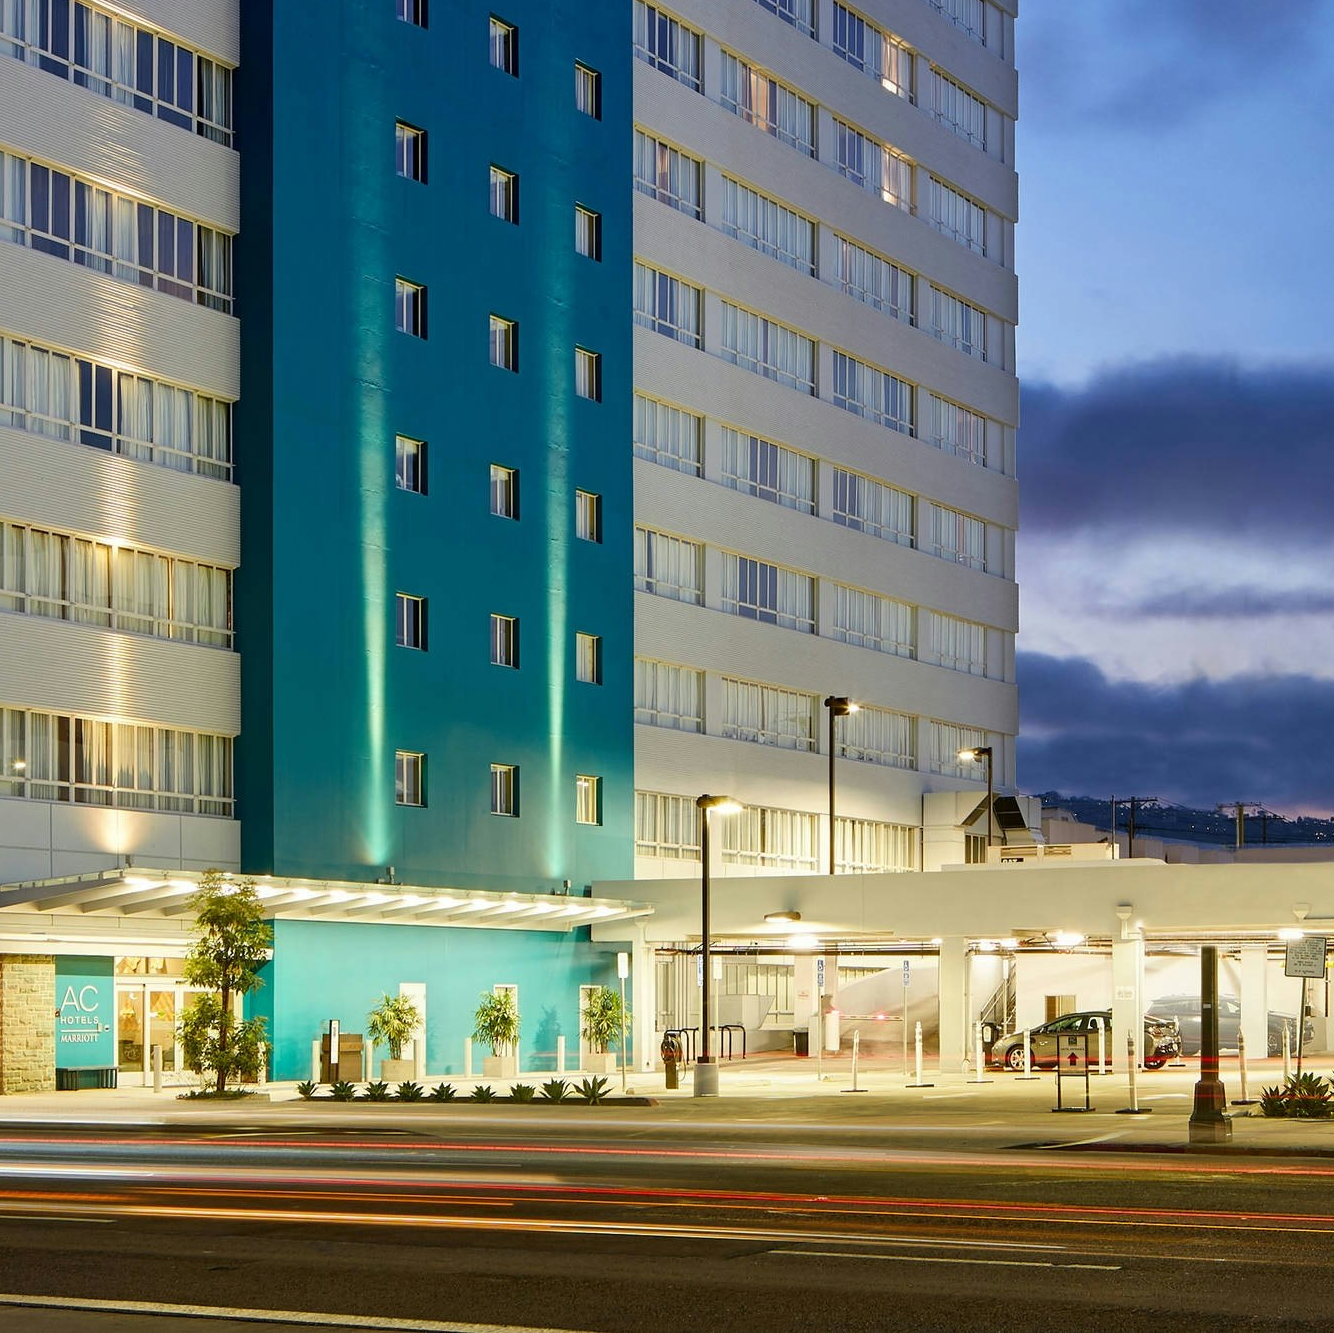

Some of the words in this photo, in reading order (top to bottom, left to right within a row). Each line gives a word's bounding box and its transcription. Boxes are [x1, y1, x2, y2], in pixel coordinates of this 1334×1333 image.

[60, 985, 99, 1012] AC
[60, 1016, 99, 1025] HOTELS
[60, 1033, 99, 1043] MARRIOTT
